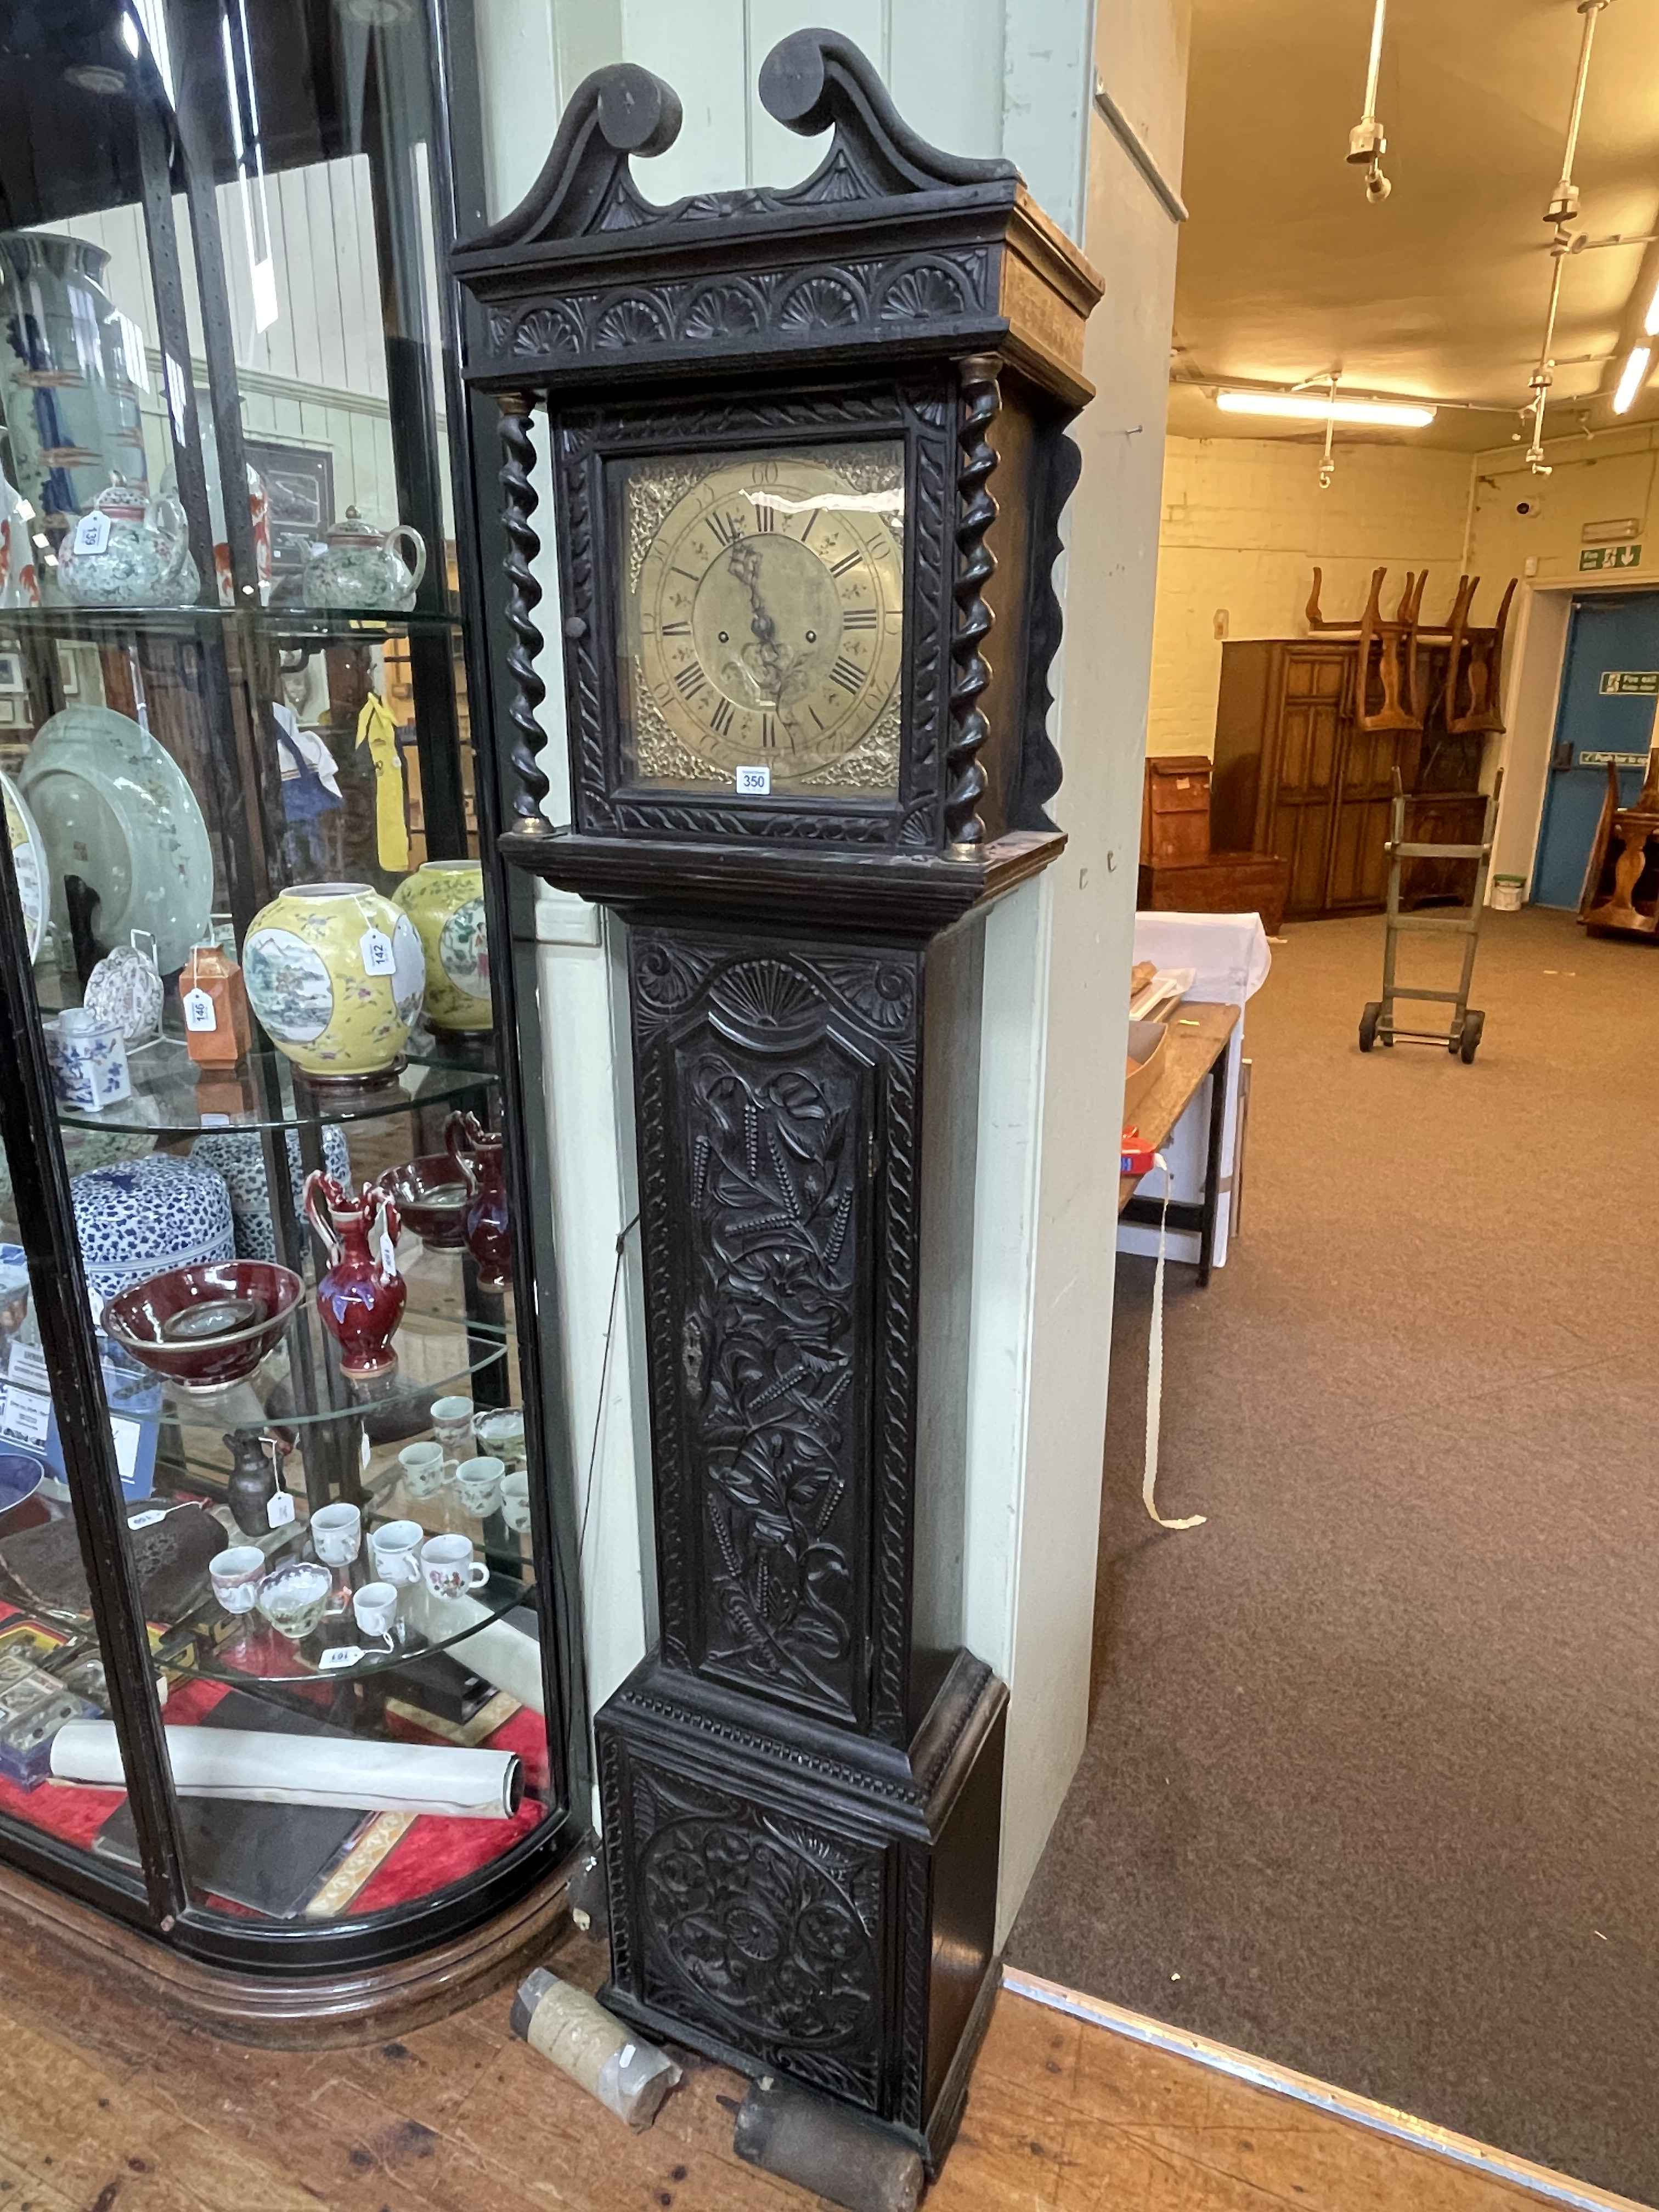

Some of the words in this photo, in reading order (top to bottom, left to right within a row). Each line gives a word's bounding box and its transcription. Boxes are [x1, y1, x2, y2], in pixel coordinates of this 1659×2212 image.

[85, 527, 97, 545] 139
[743, 775, 765, 788] 350
[374, 945, 385, 964] 142
[195, 1003, 205, 1022] 146
